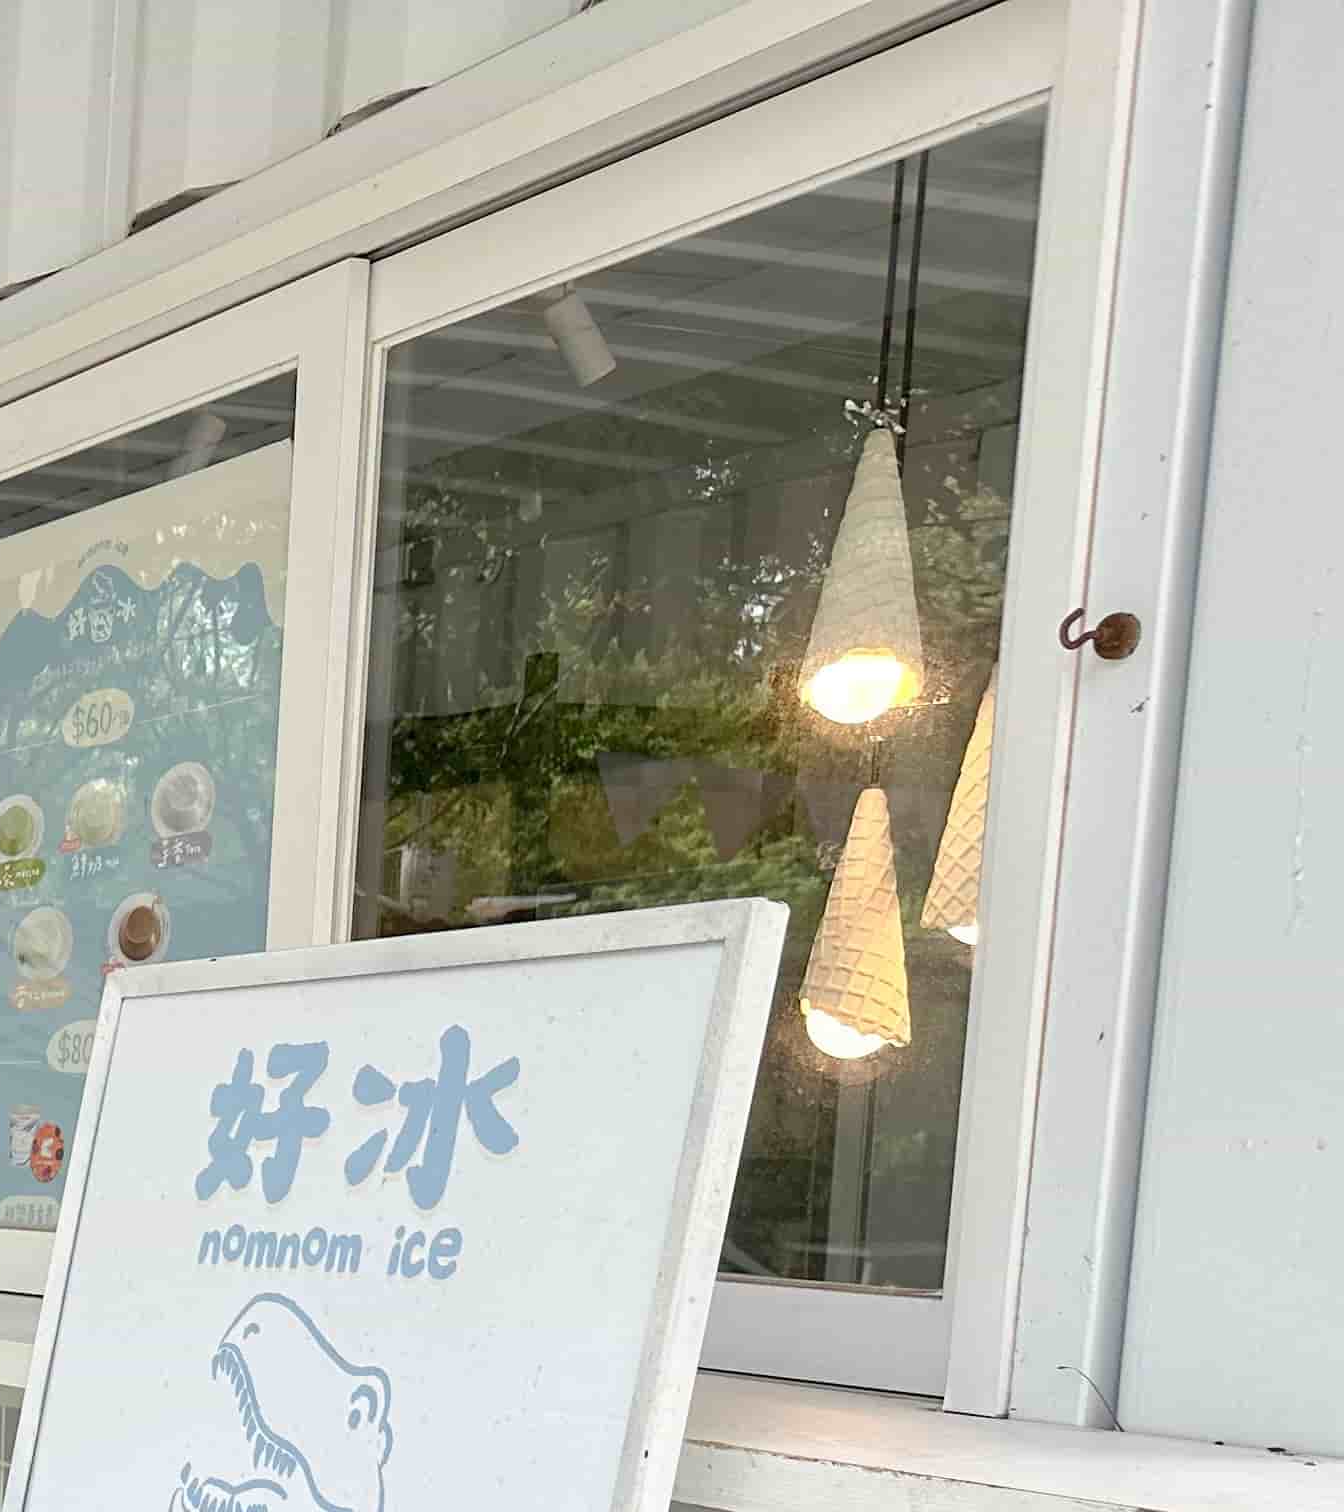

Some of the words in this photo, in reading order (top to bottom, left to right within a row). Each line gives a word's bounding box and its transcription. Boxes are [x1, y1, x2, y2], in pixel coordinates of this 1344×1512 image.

[195, 1024, 520, 1210] 好冰
[197, 1223, 362, 1274] nomnom
[386, 1225, 464, 1280] ice
